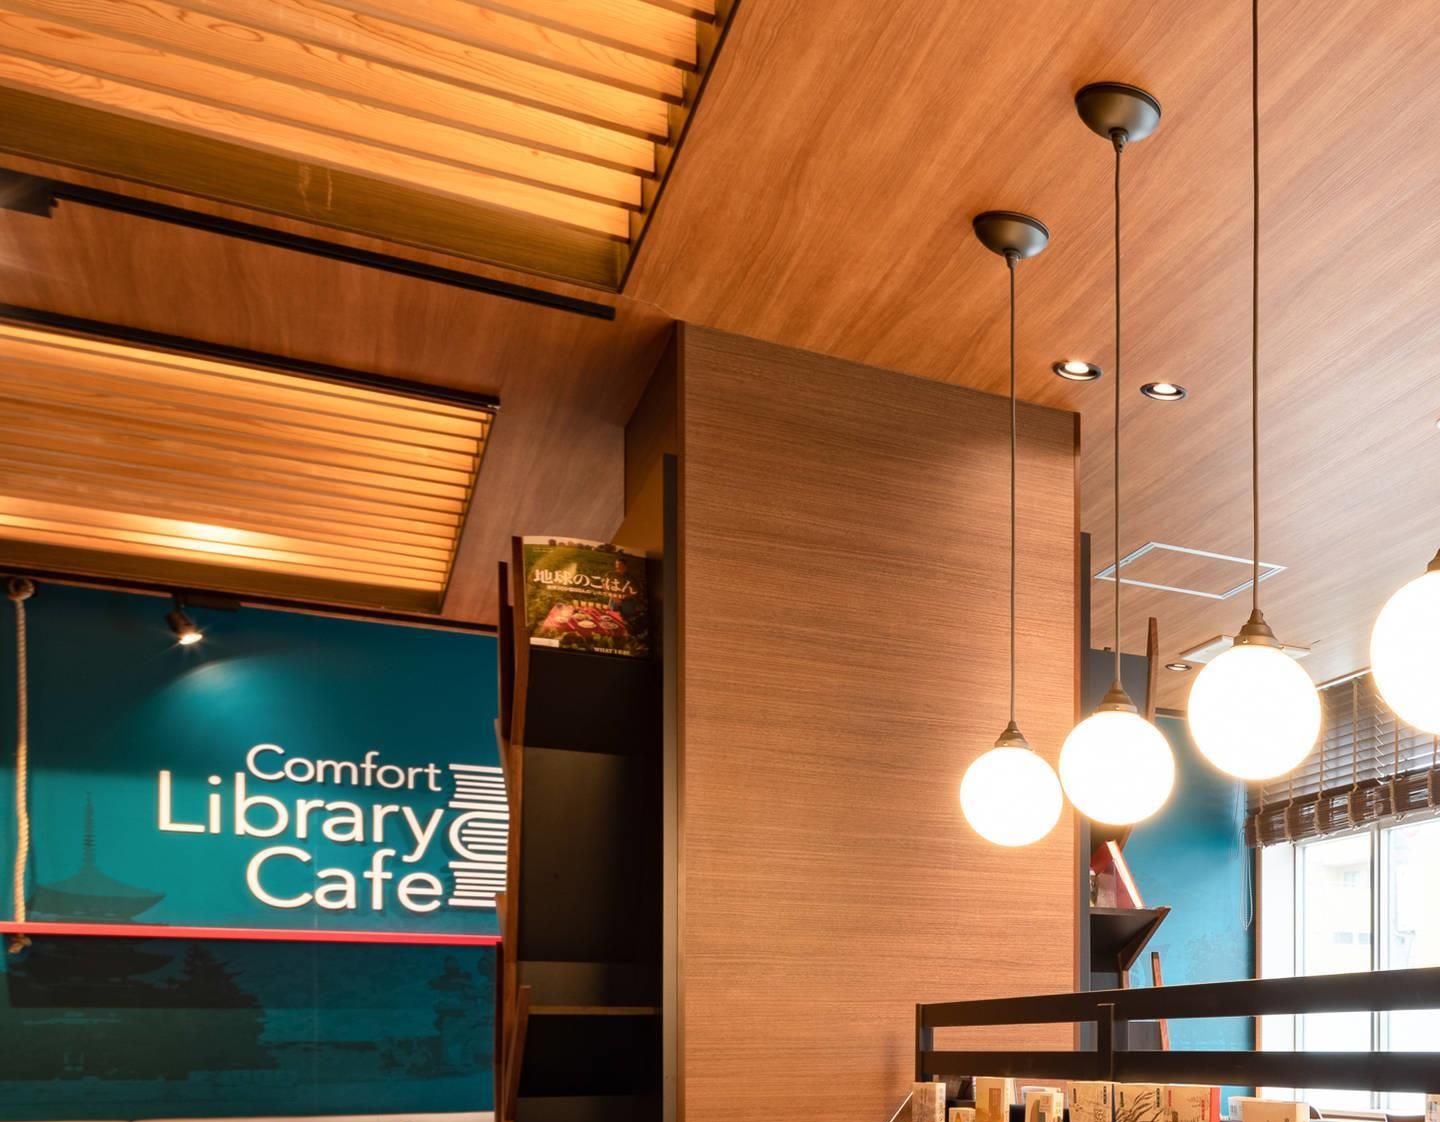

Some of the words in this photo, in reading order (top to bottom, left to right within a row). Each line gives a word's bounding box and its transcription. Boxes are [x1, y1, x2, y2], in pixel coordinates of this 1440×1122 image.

[533, 569, 638, 595] 地球のごはん
[245, 743, 443, 792] Comfort
[158, 769, 445, 864] Library
[245, 846, 443, 913] Cafe
